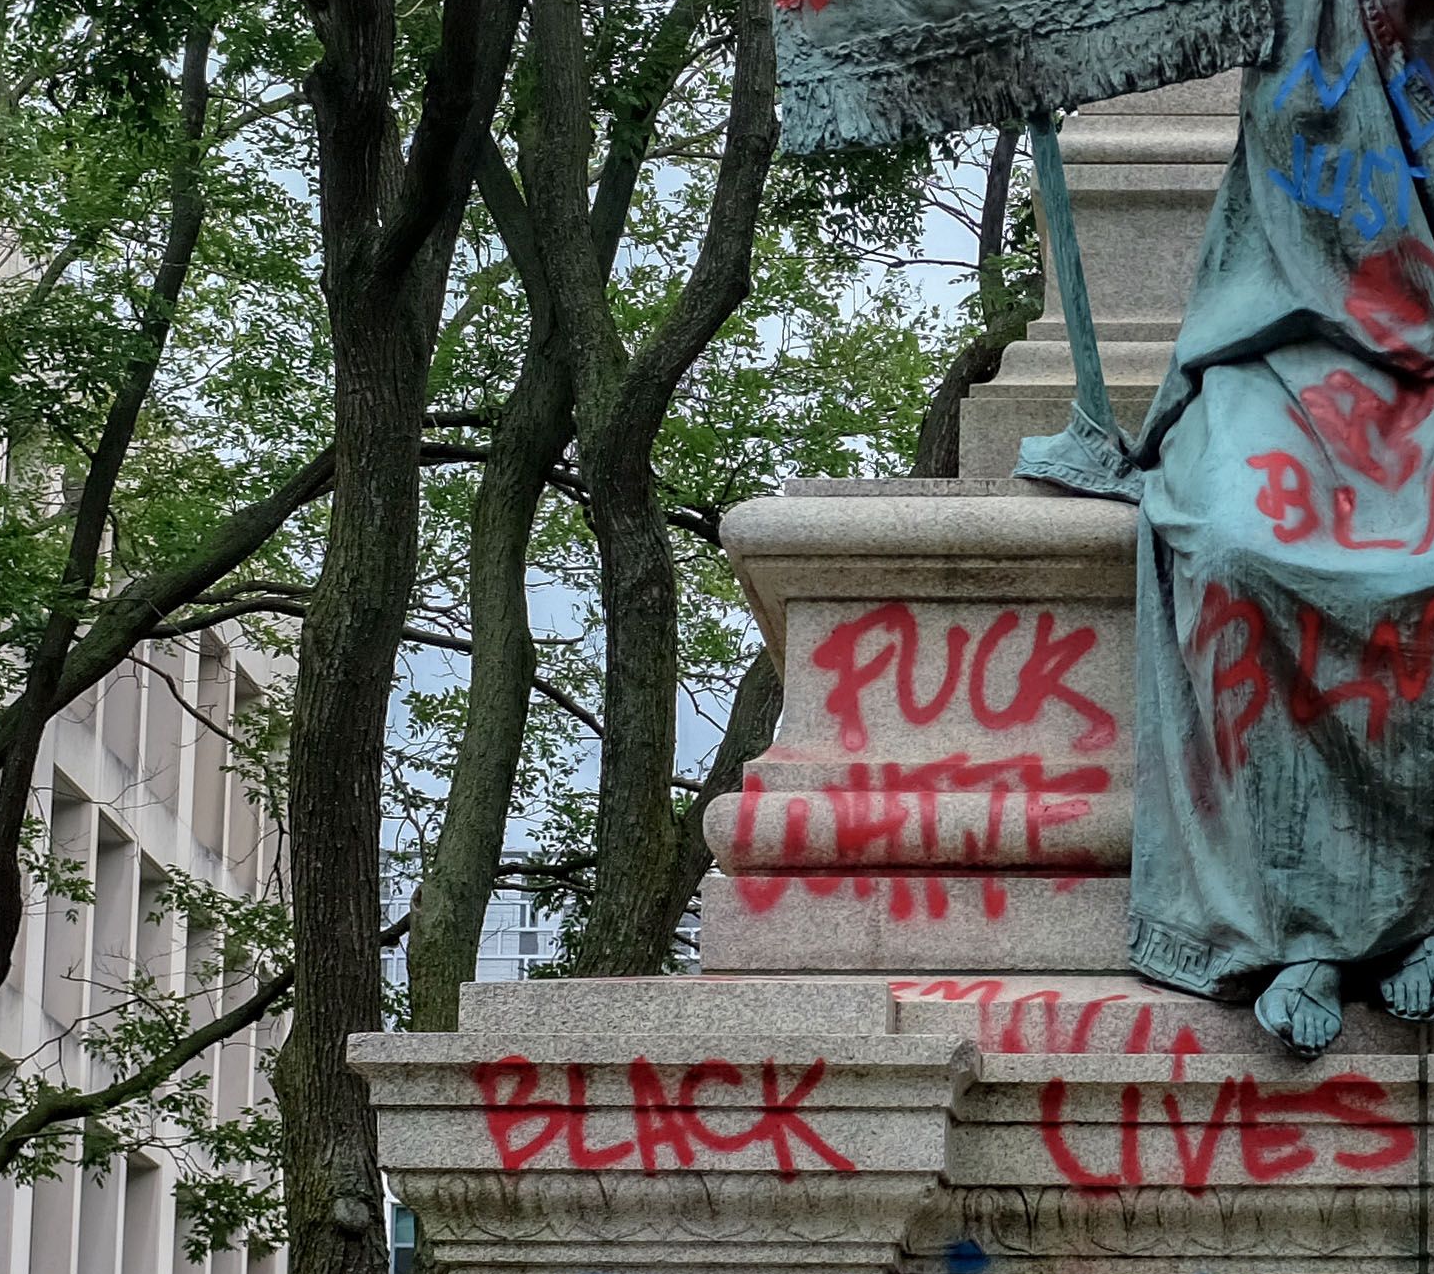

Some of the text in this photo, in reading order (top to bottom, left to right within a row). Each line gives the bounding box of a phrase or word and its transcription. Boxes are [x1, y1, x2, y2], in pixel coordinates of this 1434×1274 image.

[810, 601, 1118, 752] FUCK
[728, 751, 1111, 920] WHITE
[475, 1054, 857, 1180] BLACK
[1039, 1072, 1420, 1197] LIVES
